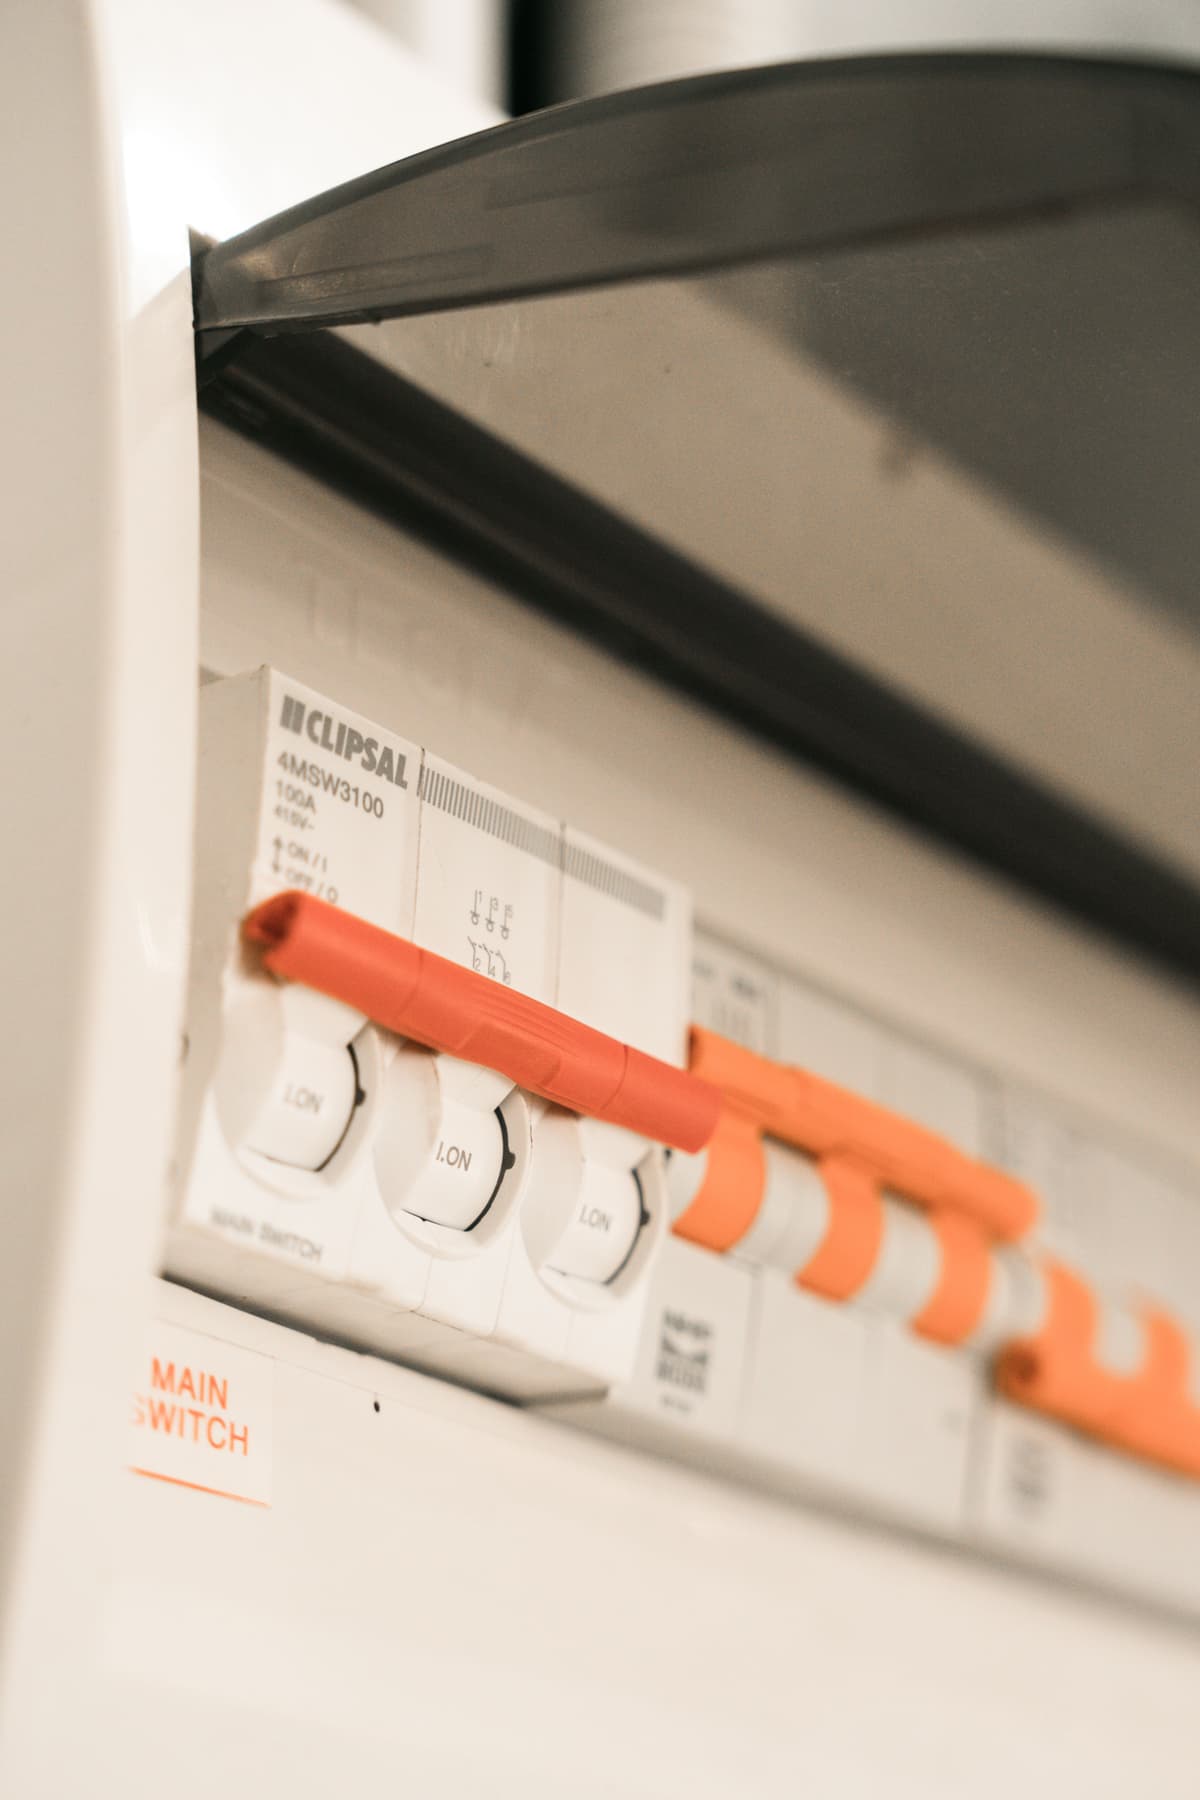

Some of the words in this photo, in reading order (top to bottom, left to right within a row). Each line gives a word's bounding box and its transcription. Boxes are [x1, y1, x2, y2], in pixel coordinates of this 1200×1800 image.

[307, 709, 409, 790] CLIPSAL
[276, 779, 317, 814] 100A
[277, 750, 385, 819] 4MSW3100
[151, 1356, 228, 1410] MAIN
